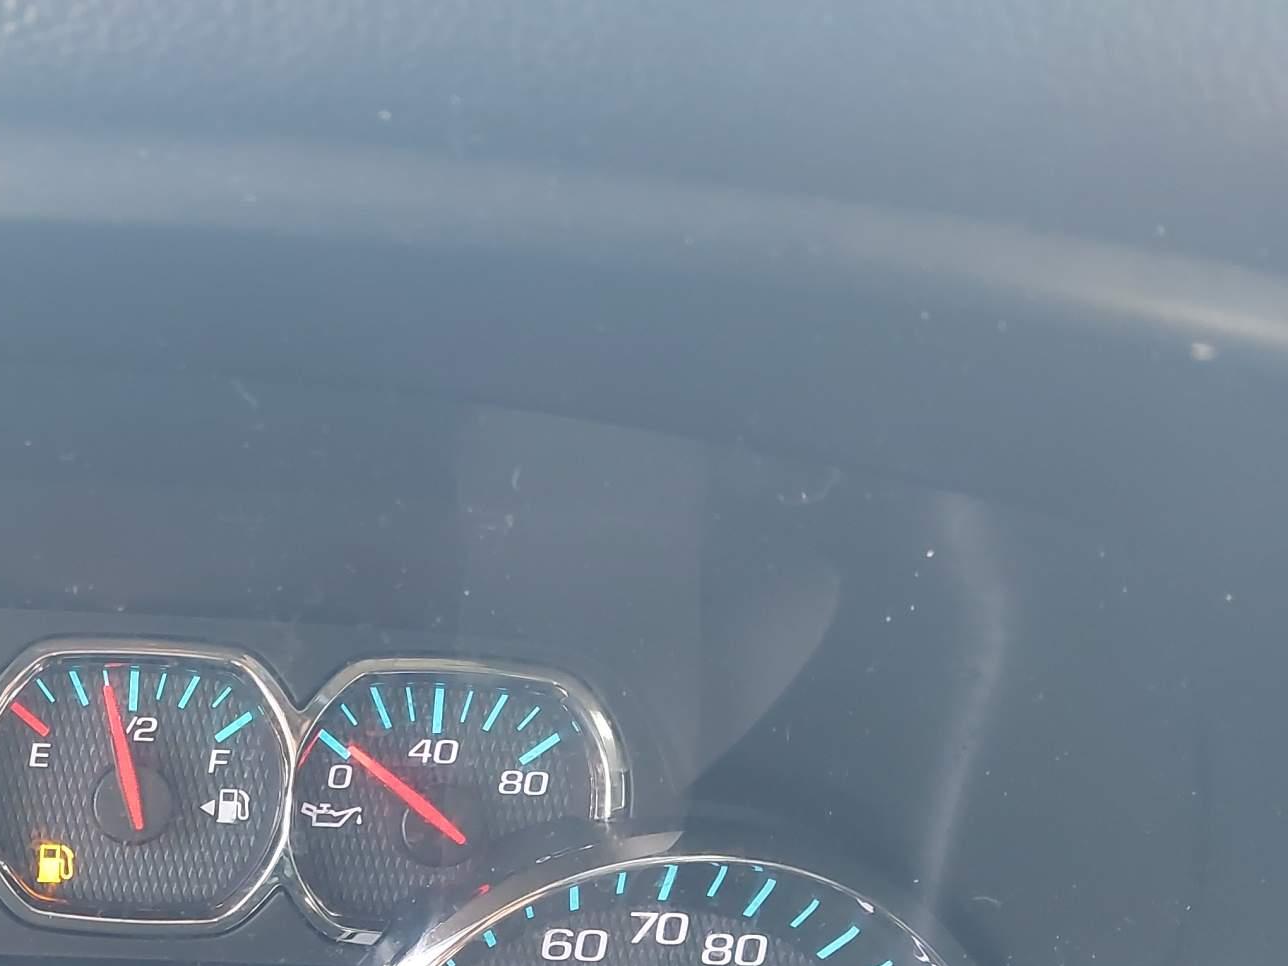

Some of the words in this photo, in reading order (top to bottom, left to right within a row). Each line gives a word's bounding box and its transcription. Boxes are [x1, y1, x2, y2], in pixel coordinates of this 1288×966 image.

[29, 744, 50, 767] E
[207, 750, 229, 774] F
[408, 740, 458, 764] 40
[327, 766, 352, 790] 0
[498, 772, 548, 796] 80
[629, 912, 690, 945] 70
[541, 929, 608, 962] 60
[701, 934, 768, 965] 80
